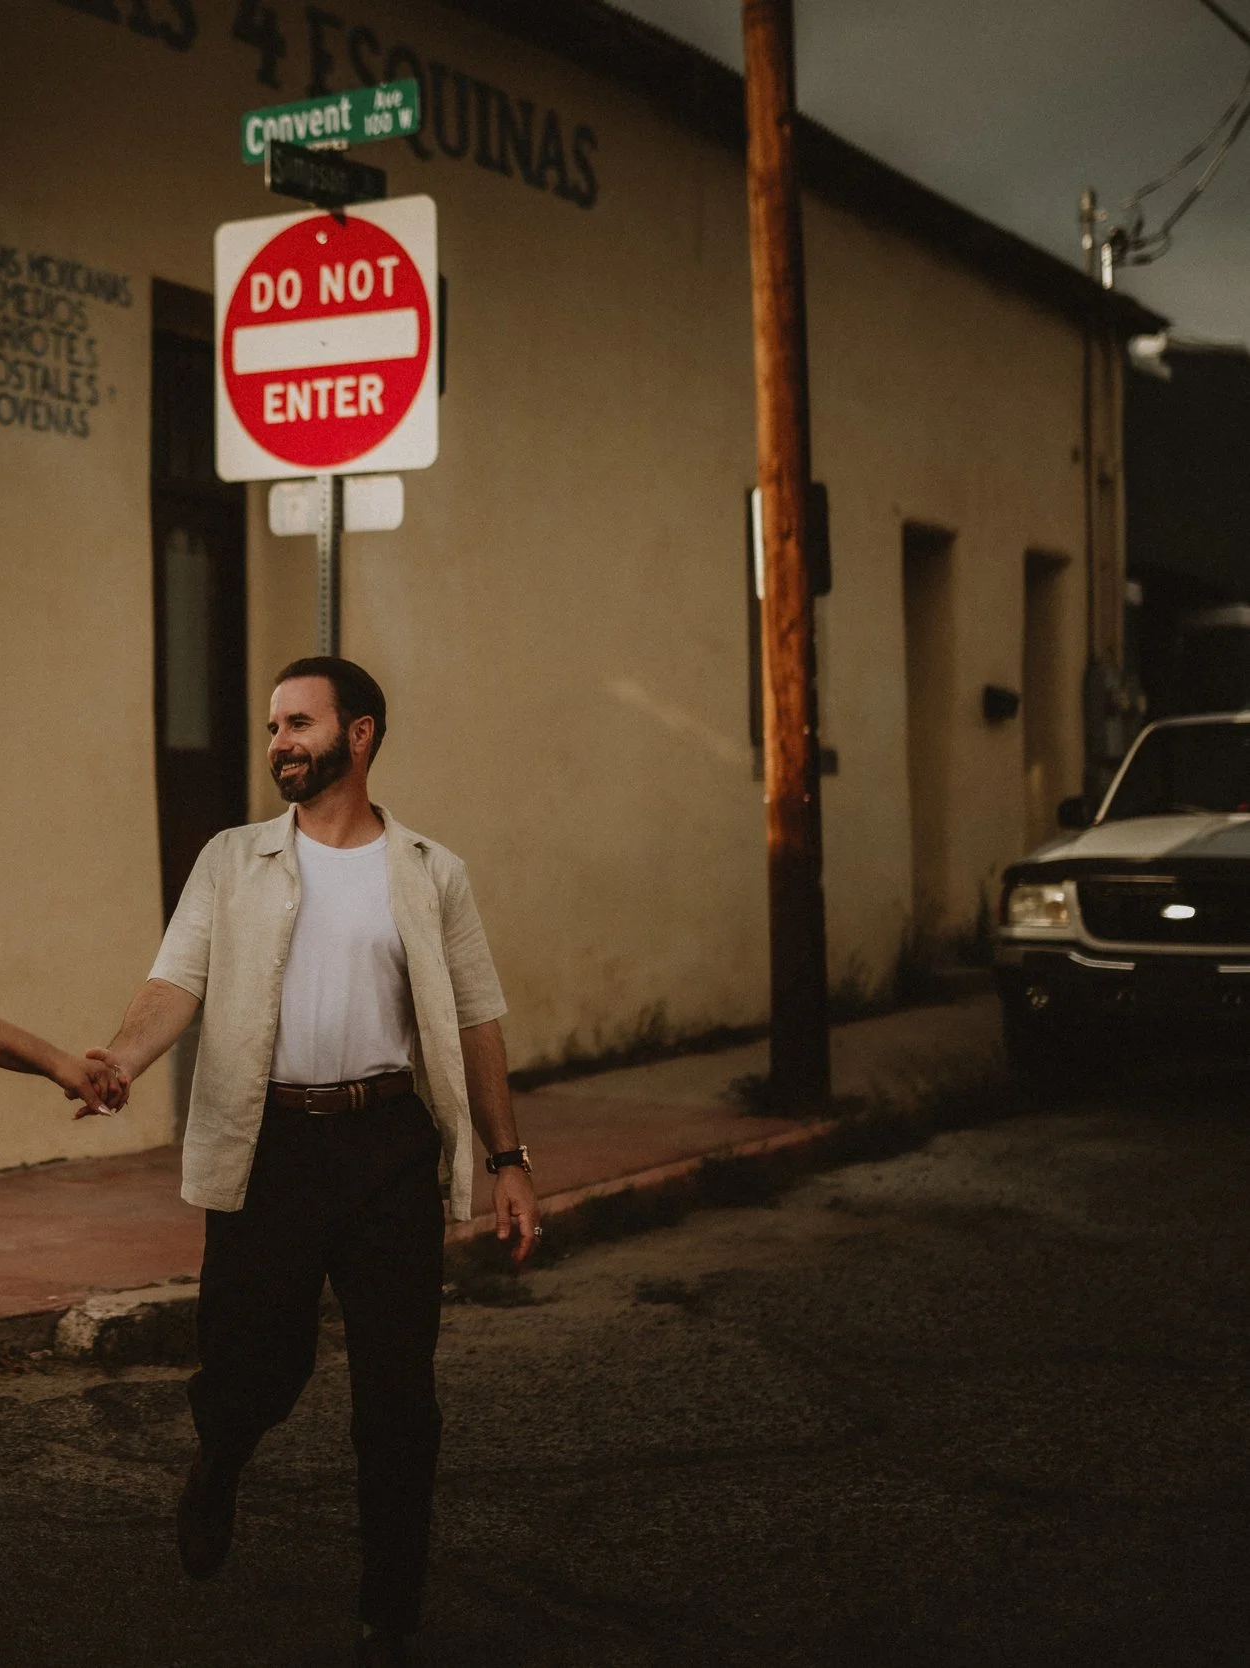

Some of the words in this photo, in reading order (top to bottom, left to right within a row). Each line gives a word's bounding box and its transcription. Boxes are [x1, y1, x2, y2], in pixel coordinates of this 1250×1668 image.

[246, 95, 353, 155] Convent
[373, 88, 403, 111] Ave
[364, 111, 393, 136] 100
[398, 107, 413, 130] W
[250, 267, 303, 313] DO
[318, 254, 401, 305] NOT
[262, 372, 386, 426] ENTER
